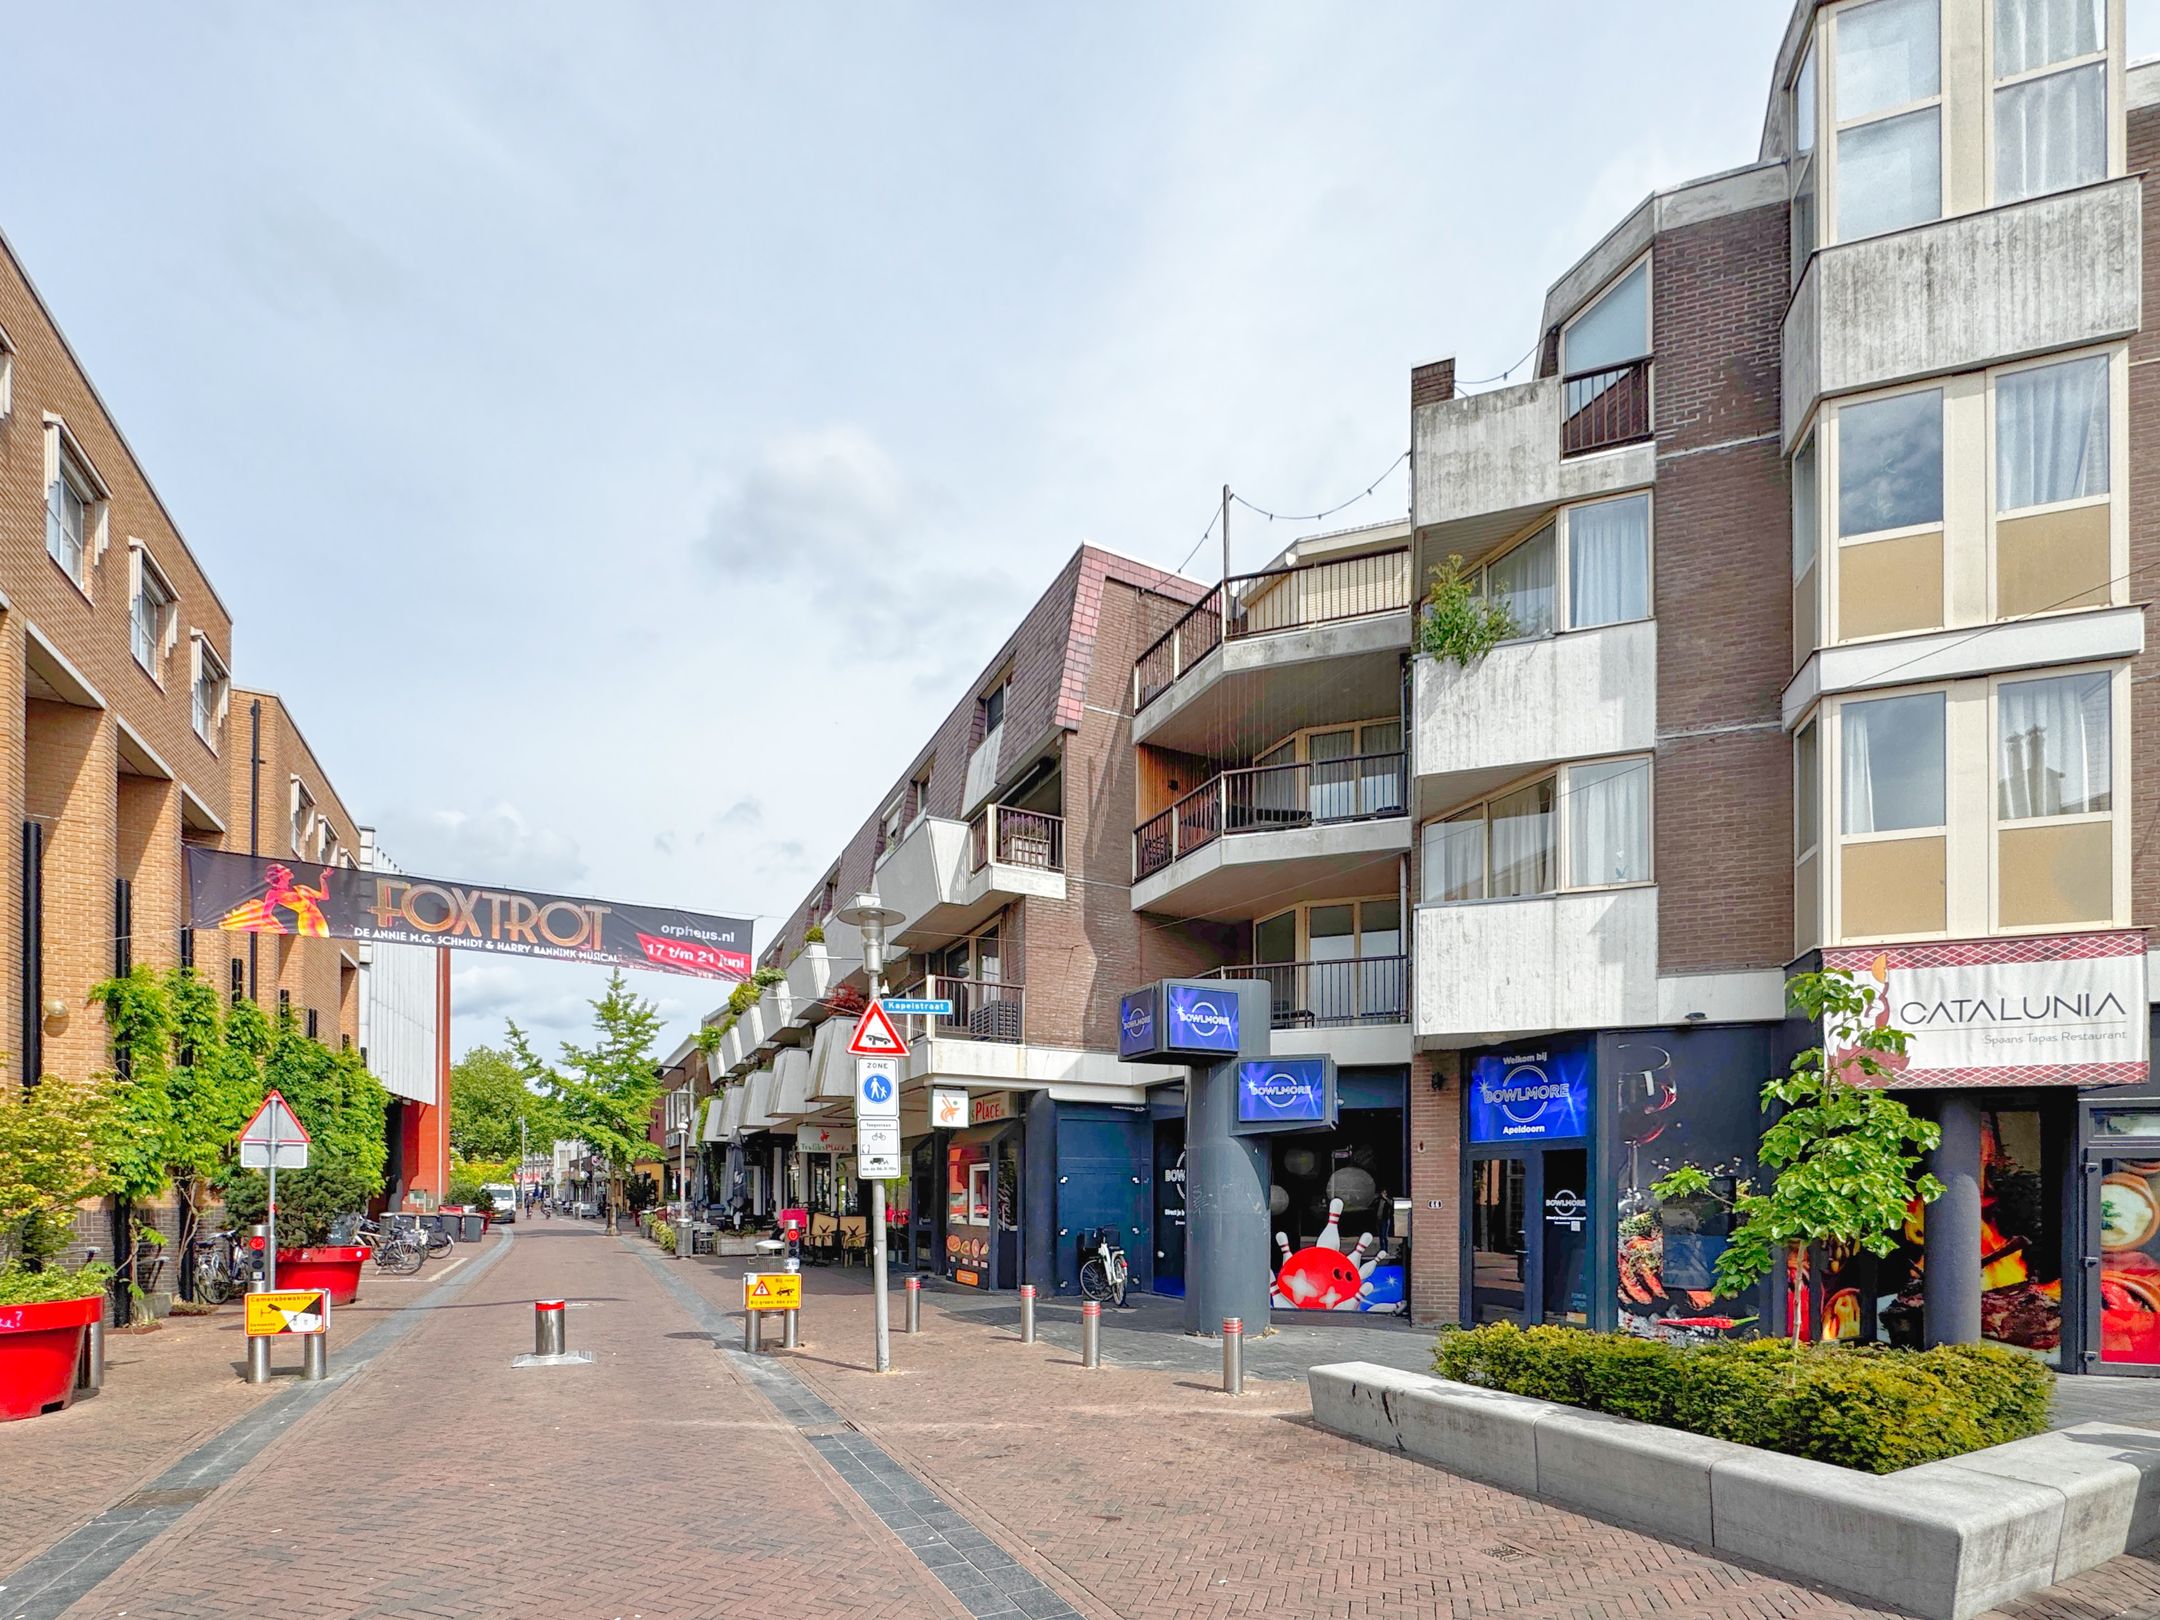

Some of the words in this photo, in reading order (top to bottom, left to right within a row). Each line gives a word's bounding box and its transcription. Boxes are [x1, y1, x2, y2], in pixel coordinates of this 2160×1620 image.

[367, 878, 611, 950] FOXTROT
[661, 924, 735, 942] orpheus.nl
[354, 927, 370, 937] DE
[372, 929, 407, 941] ANNIE
[438, 935, 483, 948] SCHMIDT
[485, 940, 494, 949] &
[497, 942, 531, 953] HARRY
[534, 946, 577, 958] BANNINK
[579, 951, 620, 963] MUSICAL
[648, 944, 665, 956] 17
[669, 946, 694, 960] t/m
[698, 951, 714, 963] 21
[718, 954, 745, 969] juni
[888, 1002, 945, 1010] Kapelstraat
[1900, 992, 2127, 1025] CATALUNIA
[1180, 1013, 1230, 1026] BOWLMORE
[1984, 1034, 2024, 1045] Spaans
[2028, 1033, 2058, 1044] Tapas
[2061, 1031, 2128, 1041] Restaurant
[1503, 1055, 1535, 1064] Welkom
[1536, 1052, 1548, 1061] bij
[1251, 1085, 1311, 1096] BOWLMORE
[1484, 1083, 1570, 1104] BOWLMORE
[1503, 1125, 1546, 1135] Apeldoorn
